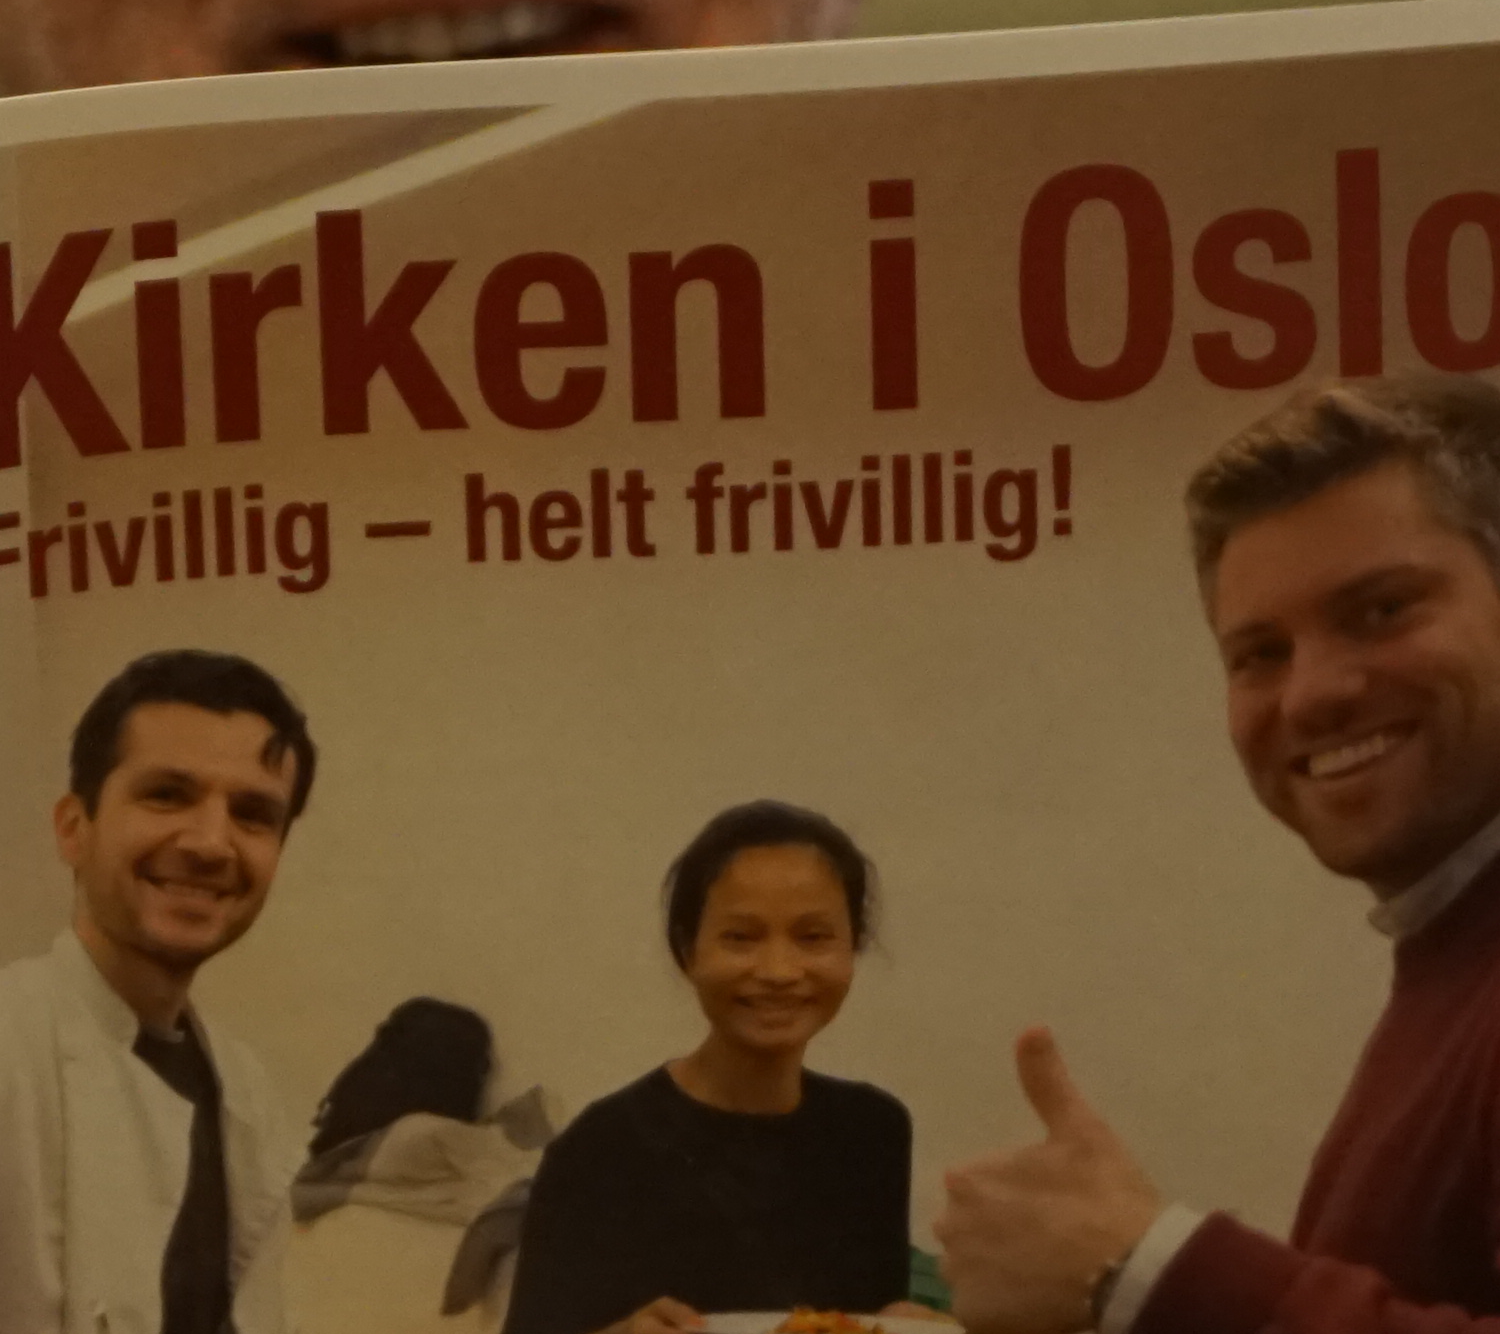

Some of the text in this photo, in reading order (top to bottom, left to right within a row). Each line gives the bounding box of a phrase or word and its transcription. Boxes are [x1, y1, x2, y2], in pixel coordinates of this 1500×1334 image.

[868, 178, 920, 412] i
[463, 465, 656, 566] helt
[684, 442, 1076, 563] frivillig!
